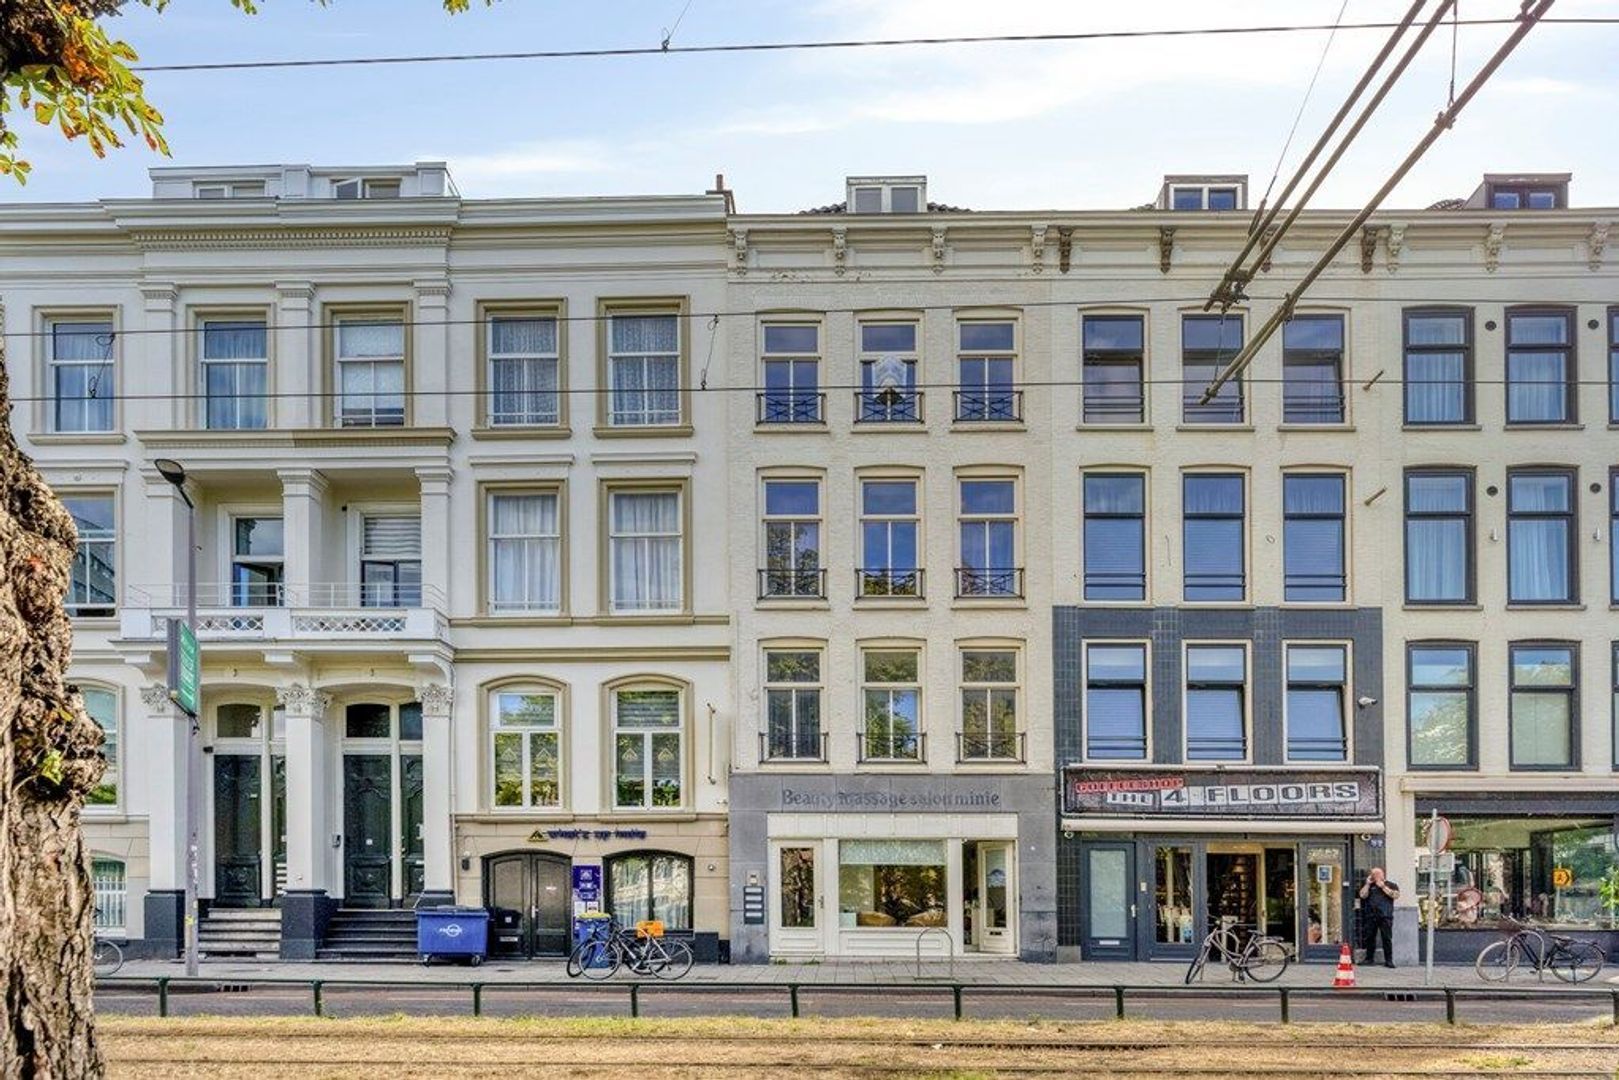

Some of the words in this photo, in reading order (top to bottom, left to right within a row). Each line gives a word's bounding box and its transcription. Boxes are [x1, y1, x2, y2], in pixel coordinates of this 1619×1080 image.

[1076, 777, 1183, 793] COFFEESHOP
[1162, 789, 1187, 803] 4
[1207, 783, 1357, 802] FLOORS
[782, 788, 833, 809] Beauty
